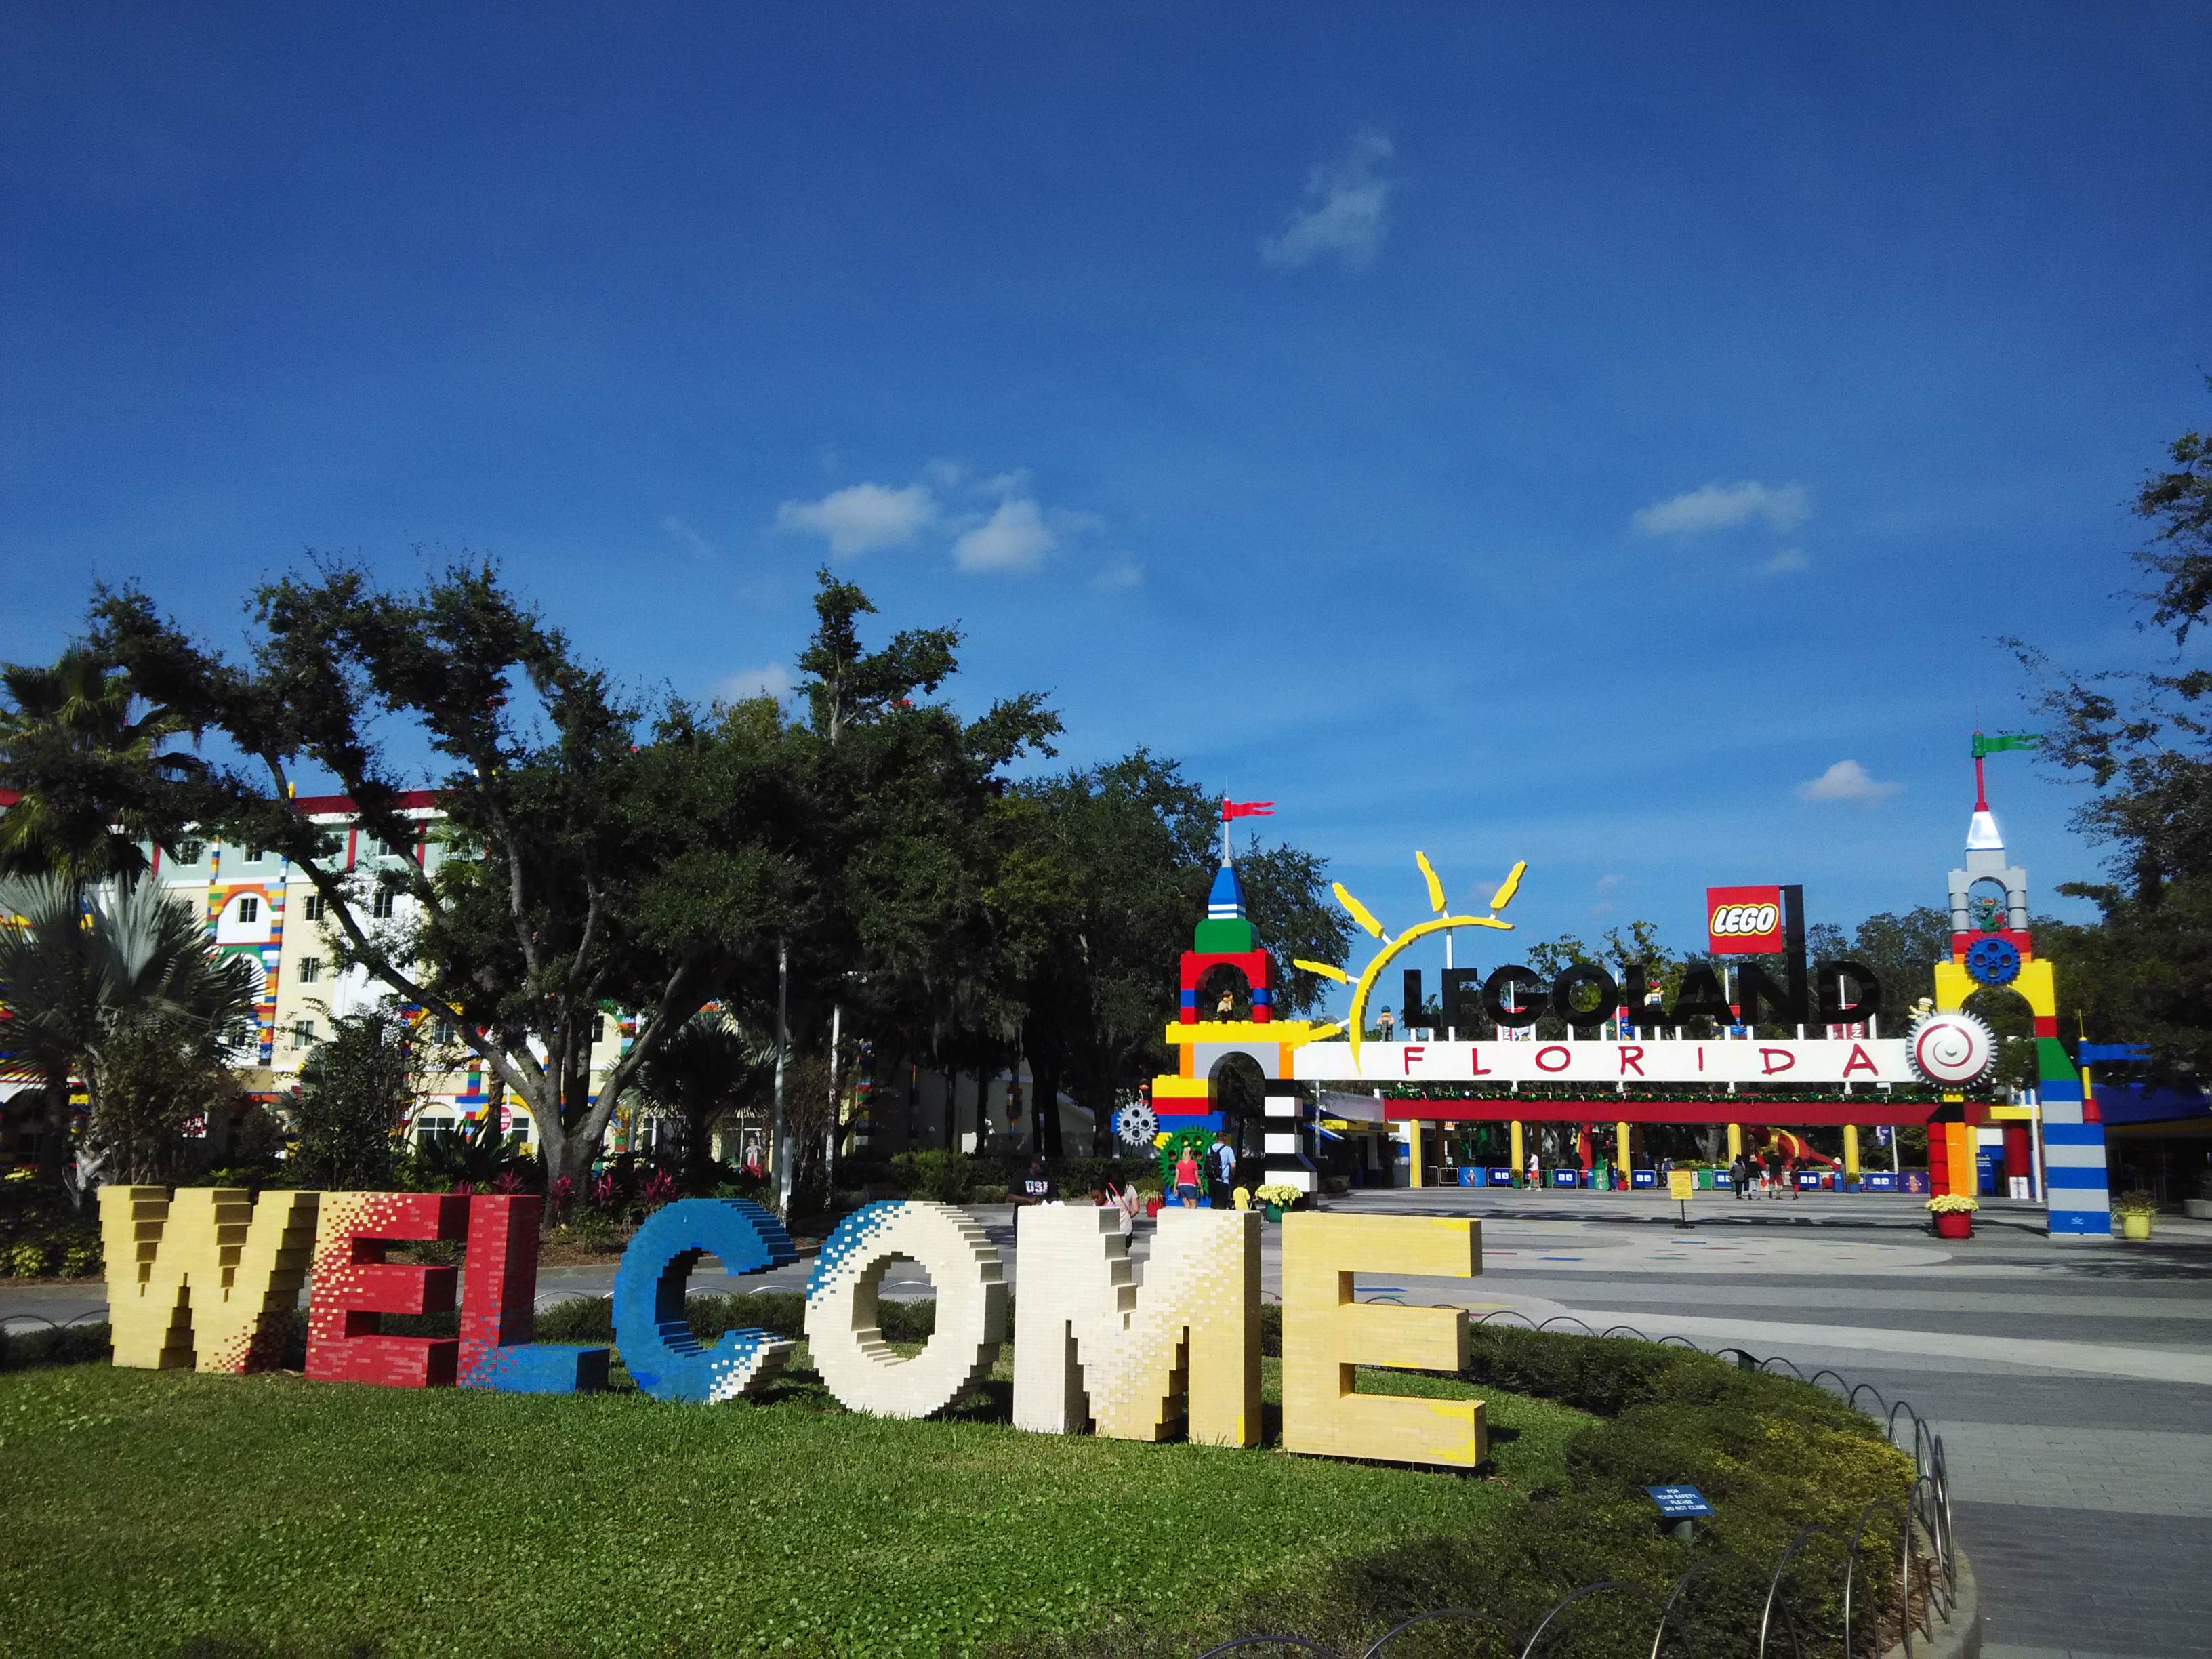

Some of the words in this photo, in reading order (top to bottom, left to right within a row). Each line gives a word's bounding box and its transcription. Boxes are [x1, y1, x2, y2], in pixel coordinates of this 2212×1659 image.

[1712, 905, 1777, 934] LEGO
[1404, 1044, 1878, 1077] FLORIDA
[97, 1185, 1487, 1468] WELCOME
